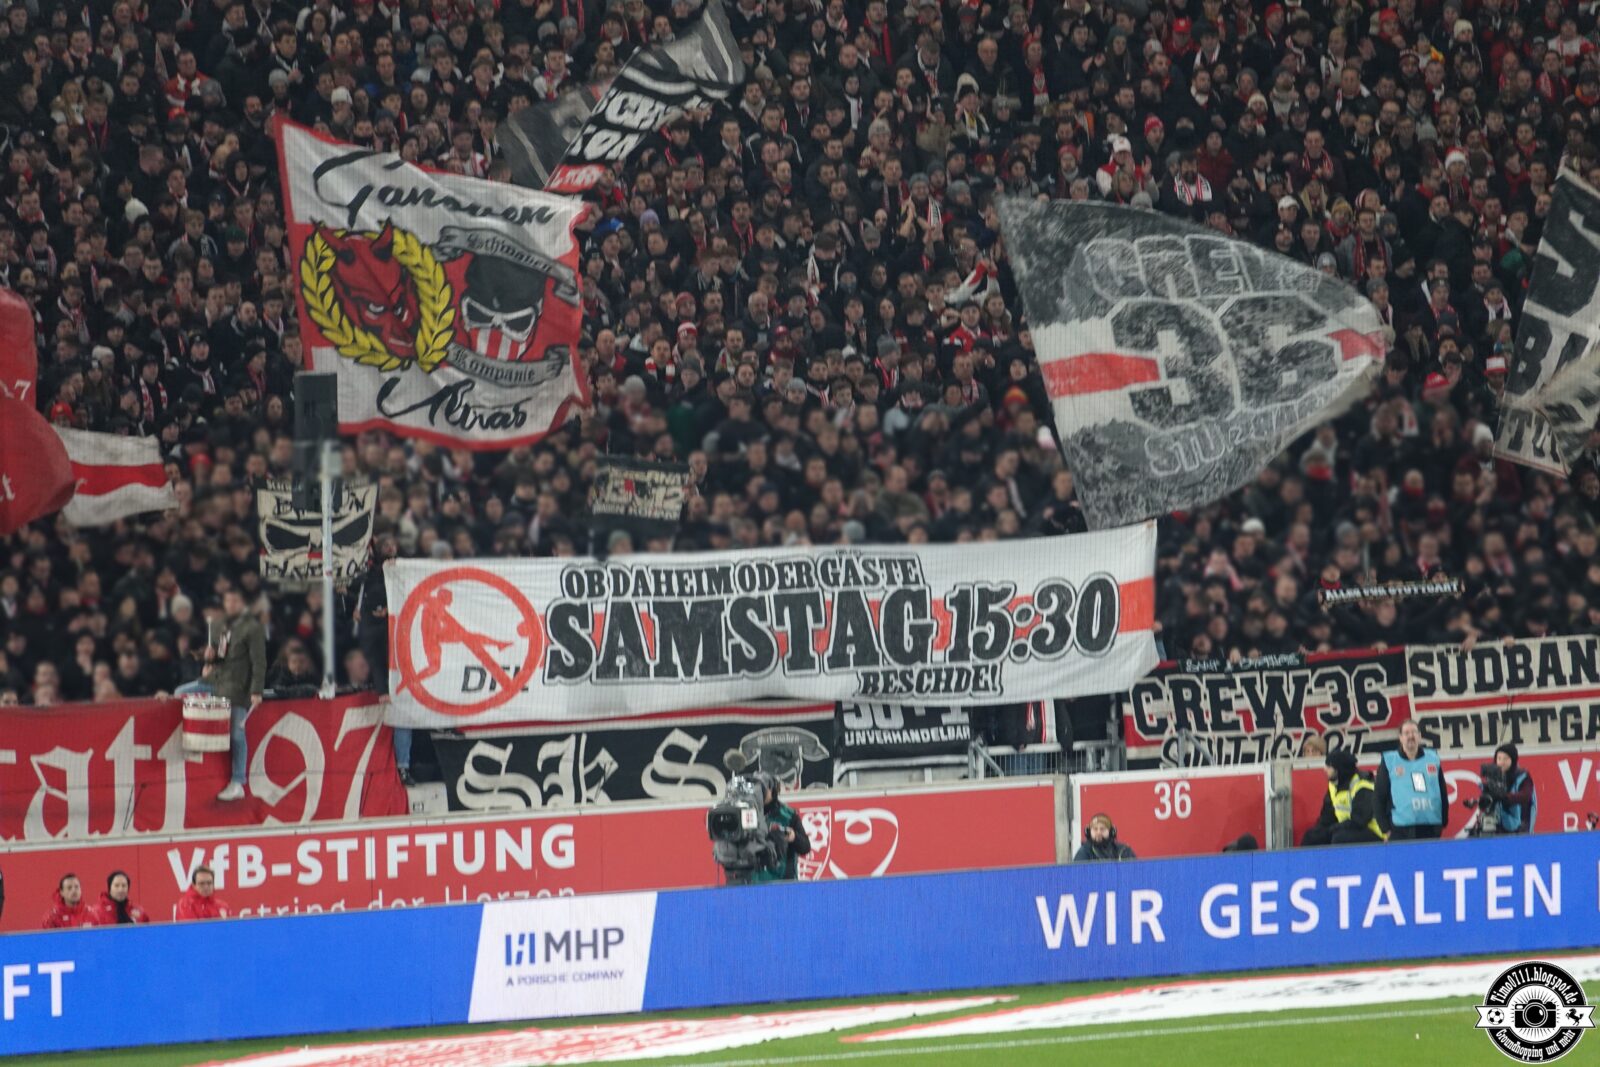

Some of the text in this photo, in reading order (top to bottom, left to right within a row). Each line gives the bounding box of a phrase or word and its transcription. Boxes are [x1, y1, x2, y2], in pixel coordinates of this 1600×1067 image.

[563, 549, 923, 598] OB DAHEIM ODER GÄSTE
[543, 574, 1120, 682] SAMSTAG 15:30
[1154, 780, 1192, 821] 36
[166, 823, 577, 893] VfB-STIFTUNG
[1036, 862, 1562, 950] WIR GESTALTEN
[545, 927, 625, 963] MHP
[505, 970, 625, 987] A PORSCHE COMPANY
